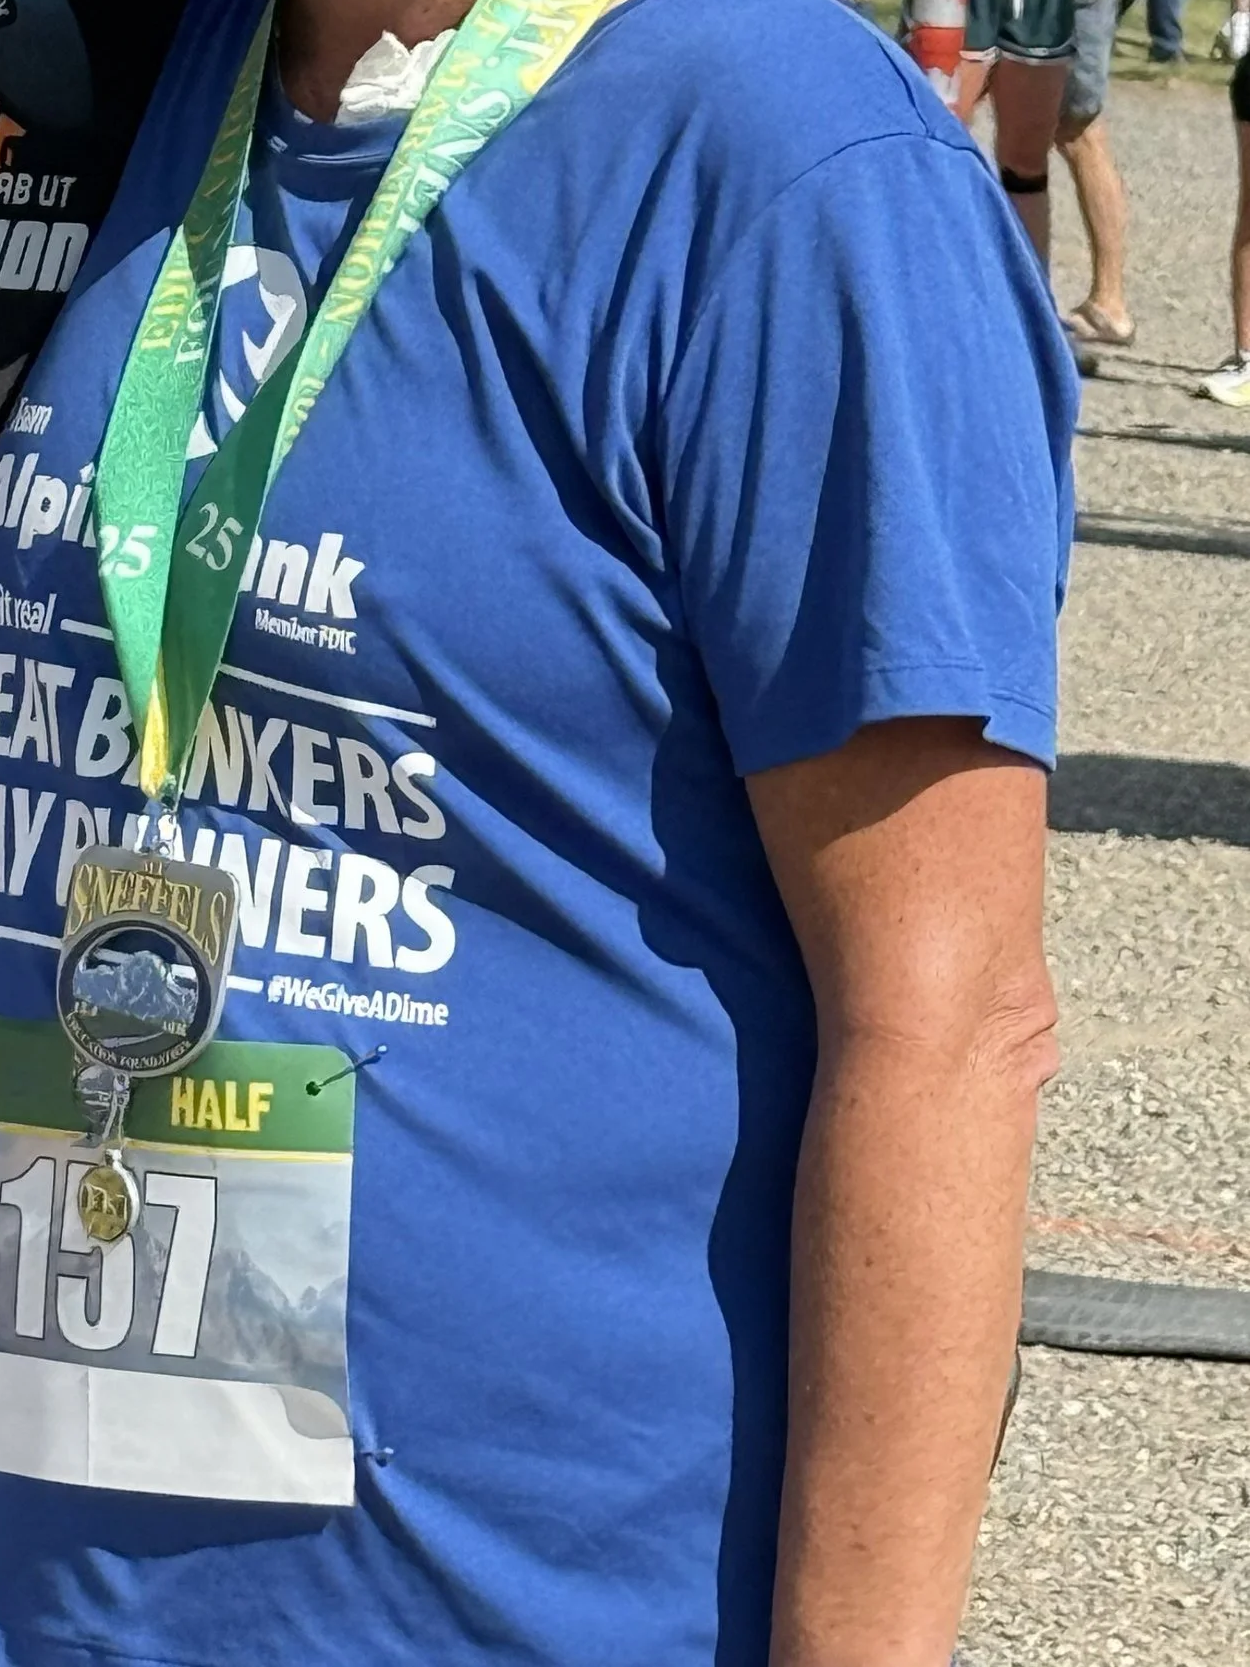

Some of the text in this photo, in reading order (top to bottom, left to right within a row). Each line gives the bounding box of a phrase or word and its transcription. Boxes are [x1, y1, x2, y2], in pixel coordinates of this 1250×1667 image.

[38, 174, 78, 209] UT
[98, 523, 159, 579] 25
[185, 501, 244, 571] 25
[14, 592, 58, 635] real
[255, 607, 358, 655] Member FDIC
[75, 676, 446, 840] BNKERS
[67, 863, 228, 967] SNEFFELS
[267, 974, 450, 1027] #WeGiveADime
[170, 1077, 274, 1132] HALF
